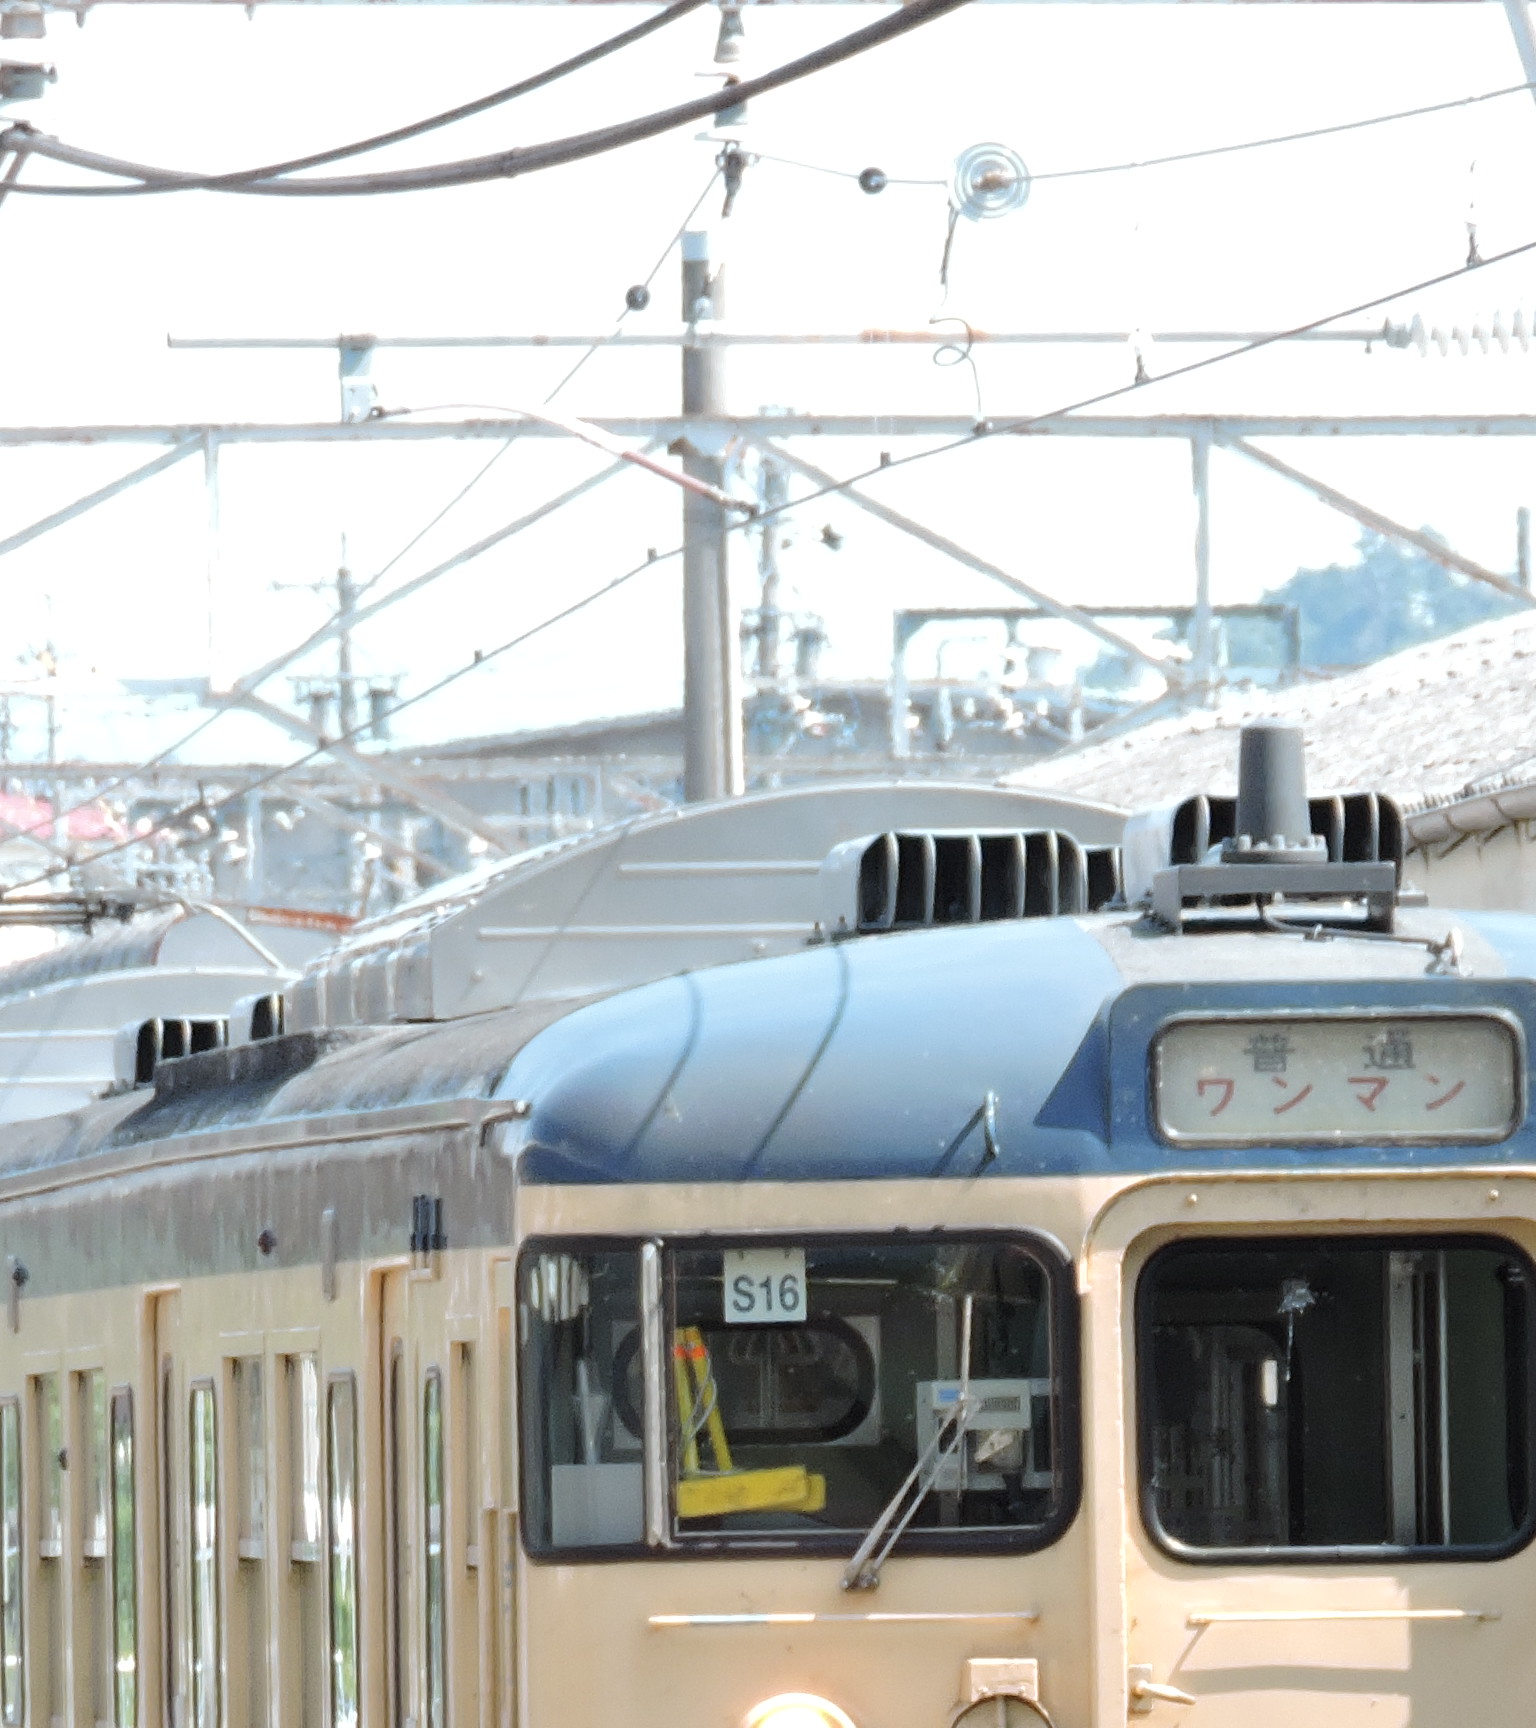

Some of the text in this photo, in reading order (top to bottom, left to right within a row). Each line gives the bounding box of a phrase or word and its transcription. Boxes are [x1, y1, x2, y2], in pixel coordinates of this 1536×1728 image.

[1243, 1026, 1416, 1073] 普通
[1196, 1074, 1465, 1117] ワンマン
[731, 1274, 800, 1314] S16
